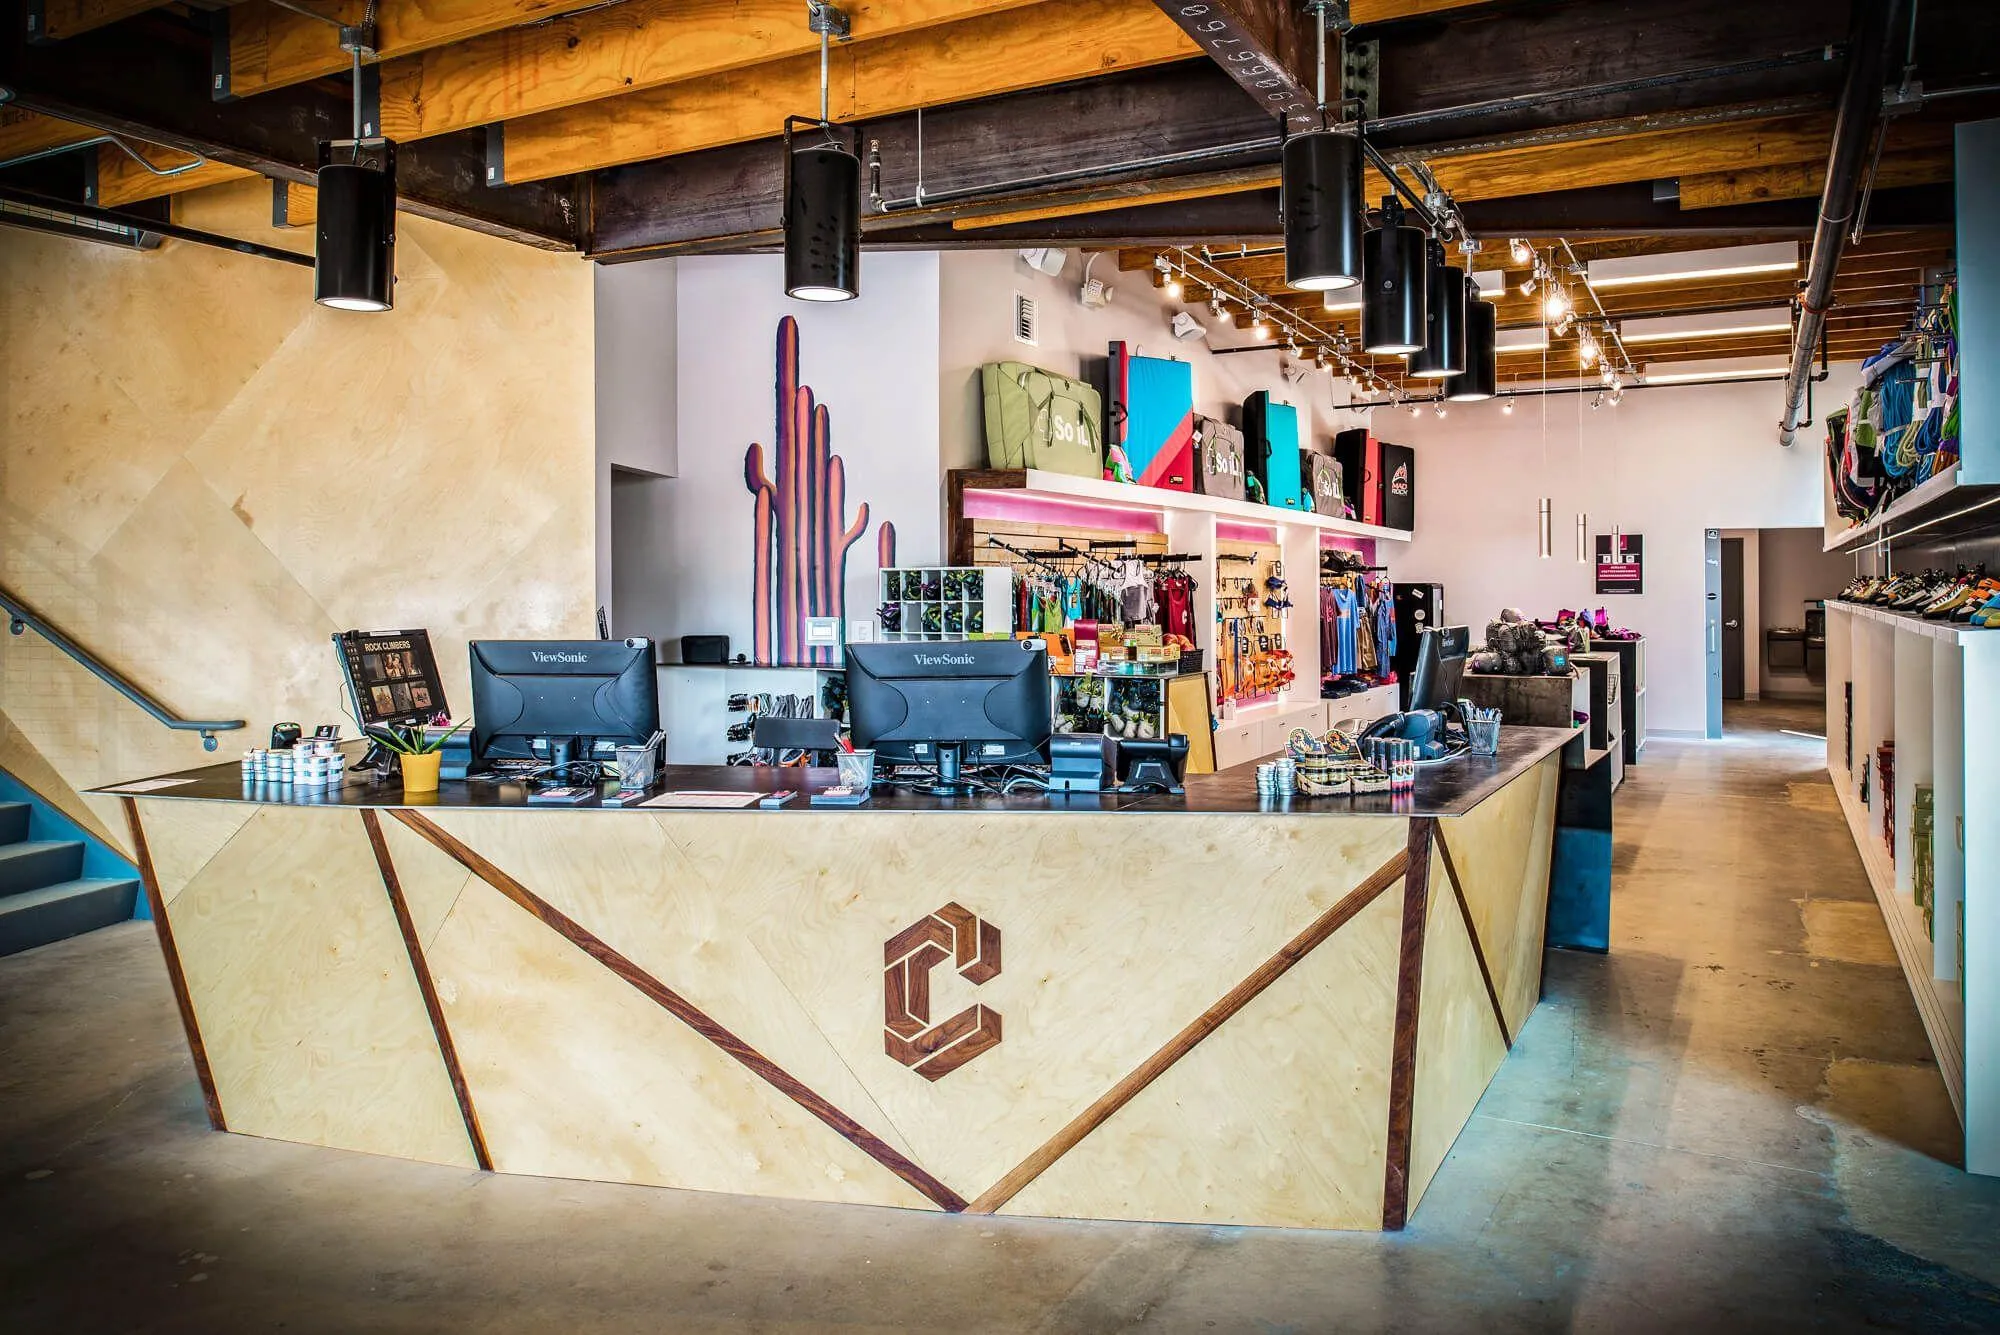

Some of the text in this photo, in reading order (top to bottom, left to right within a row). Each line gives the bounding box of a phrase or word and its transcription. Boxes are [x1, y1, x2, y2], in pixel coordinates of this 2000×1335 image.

[1054, 414, 1074, 442] So
[1216, 452, 1228, 474] So
[1392, 482, 1408, 490] MAD
[364, 642, 383, 652] ROCK
[531, 651, 588, 663] ViewSonic
[913, 653, 975, 665] ViewSonic
